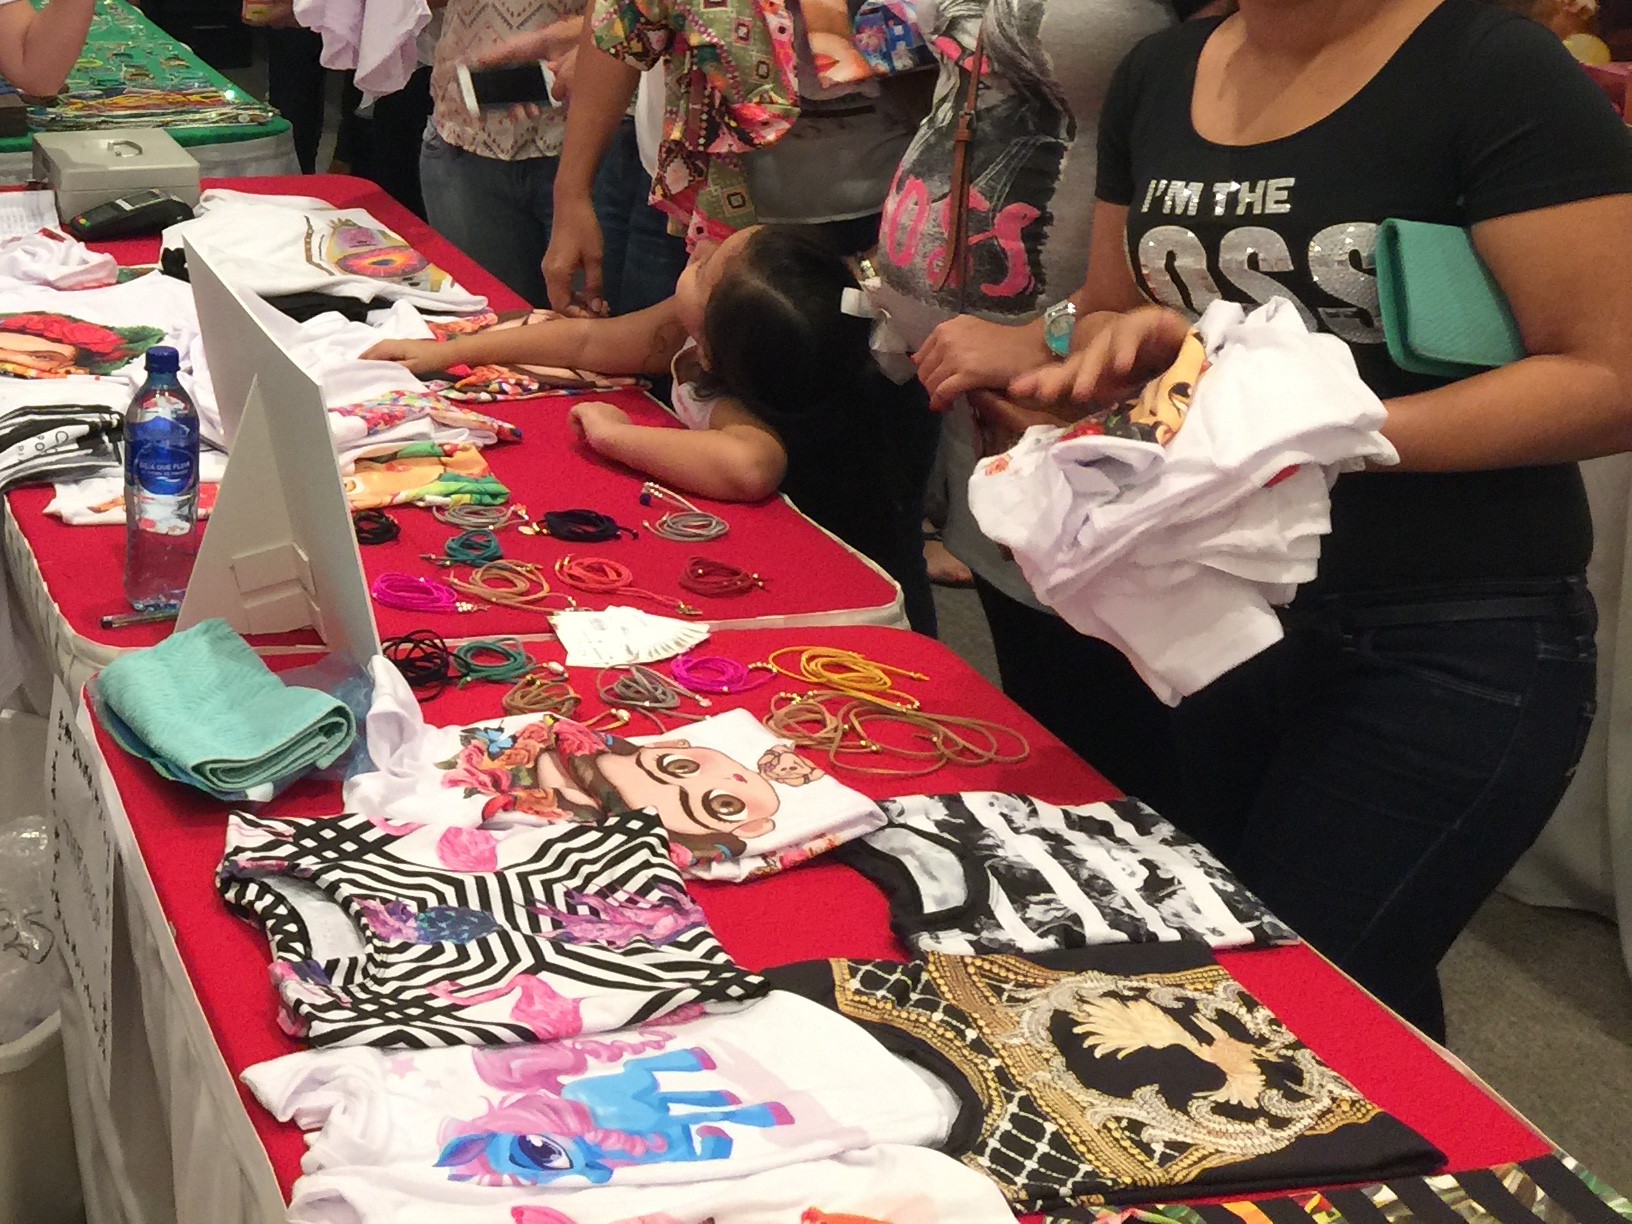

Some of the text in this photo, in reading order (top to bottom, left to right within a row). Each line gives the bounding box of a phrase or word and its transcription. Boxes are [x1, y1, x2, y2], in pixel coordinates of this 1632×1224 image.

[1141, 177, 1296, 216] I'M THE
[1133, 222, 1383, 344] OSS
